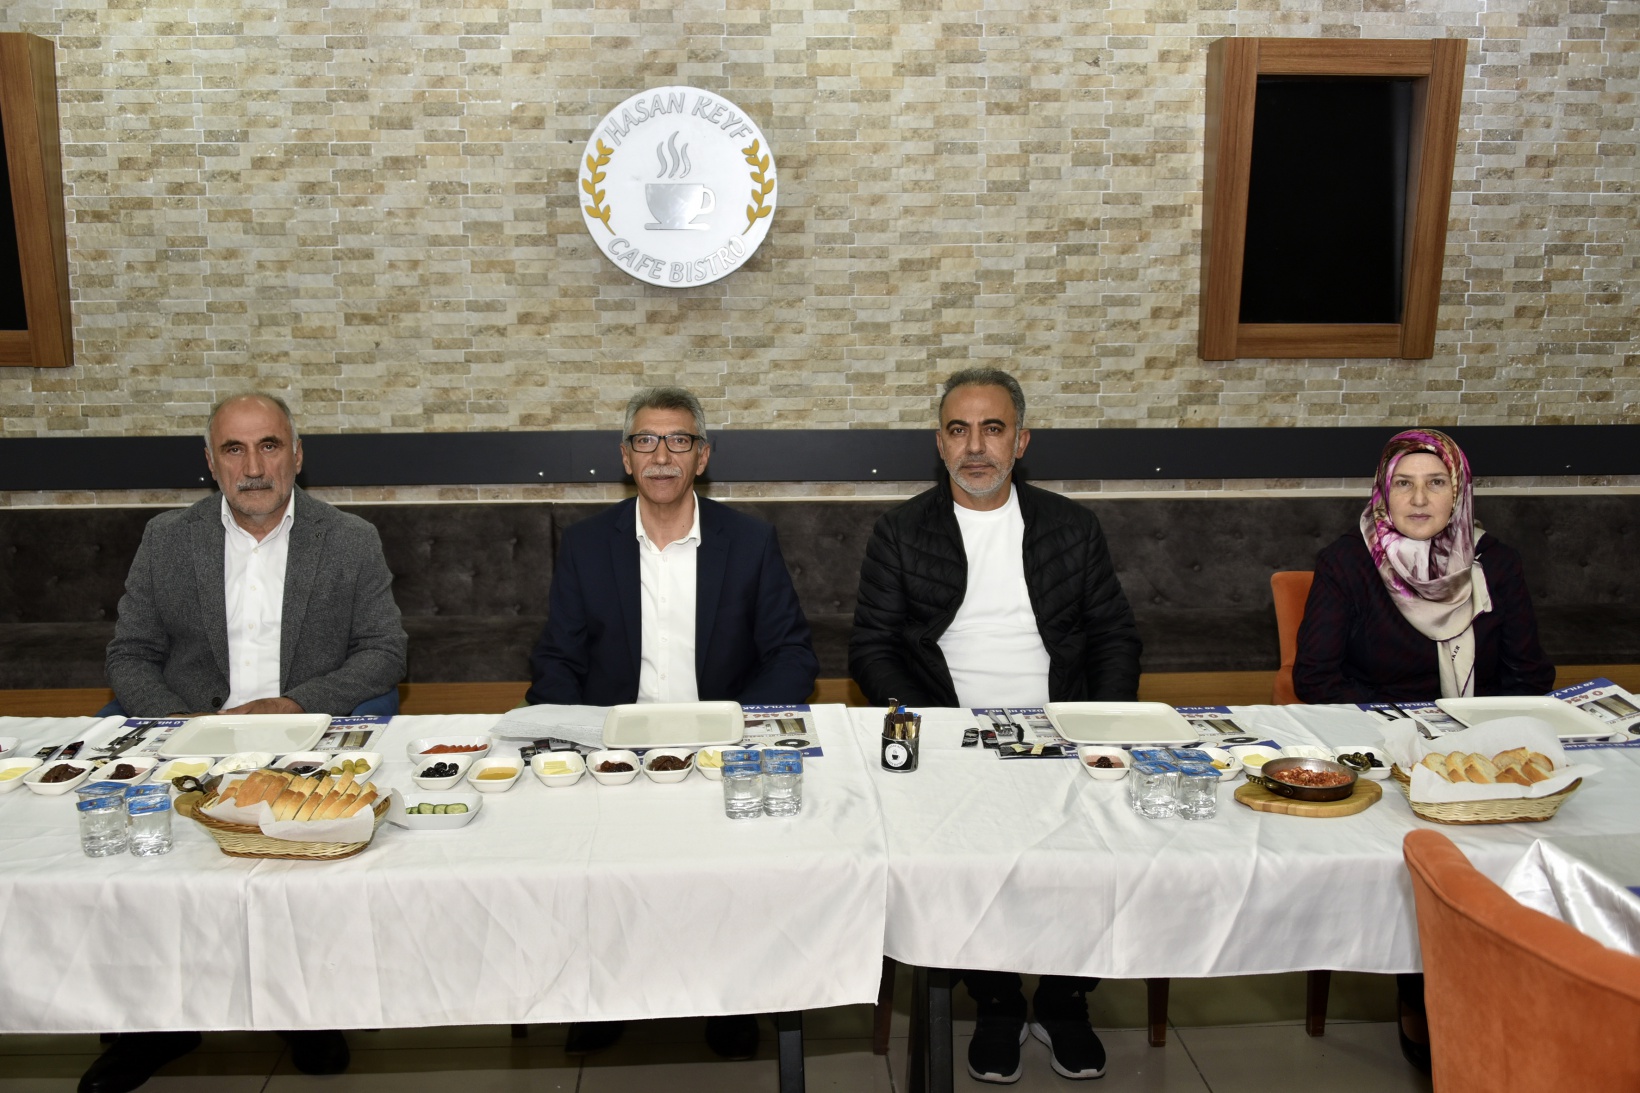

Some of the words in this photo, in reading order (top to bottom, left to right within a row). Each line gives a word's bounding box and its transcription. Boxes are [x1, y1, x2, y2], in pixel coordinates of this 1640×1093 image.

[604, 92, 685, 147] HASAN
[691, 95, 754, 140] KEYF
[607, 237, 667, 280] CAFE
[669, 234, 746, 283] BISTRO
